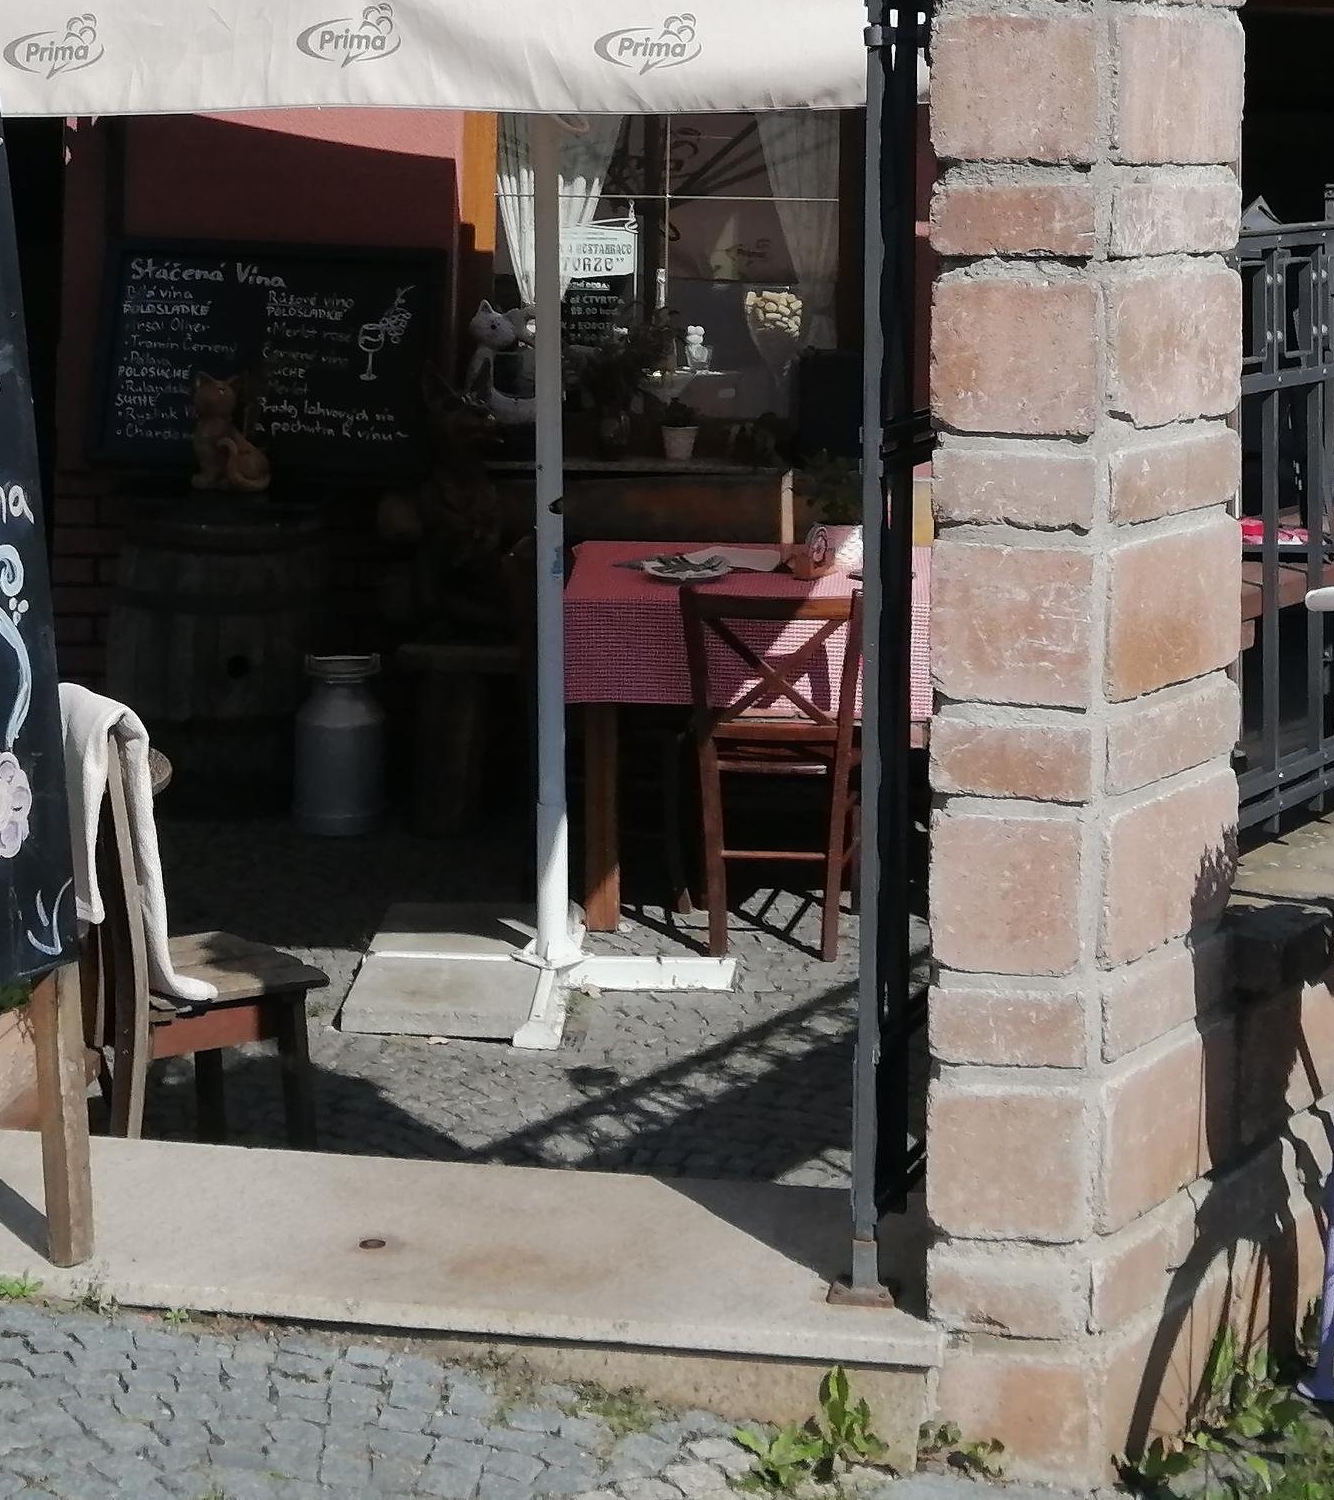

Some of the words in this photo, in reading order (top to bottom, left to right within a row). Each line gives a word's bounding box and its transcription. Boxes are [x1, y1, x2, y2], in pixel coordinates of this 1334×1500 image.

[24, 39, 90, 65] Prima
[318, 27, 388, 55] Prima
[616, 33, 689, 61] Prima
[130, 257, 227, 283] Stáčená
